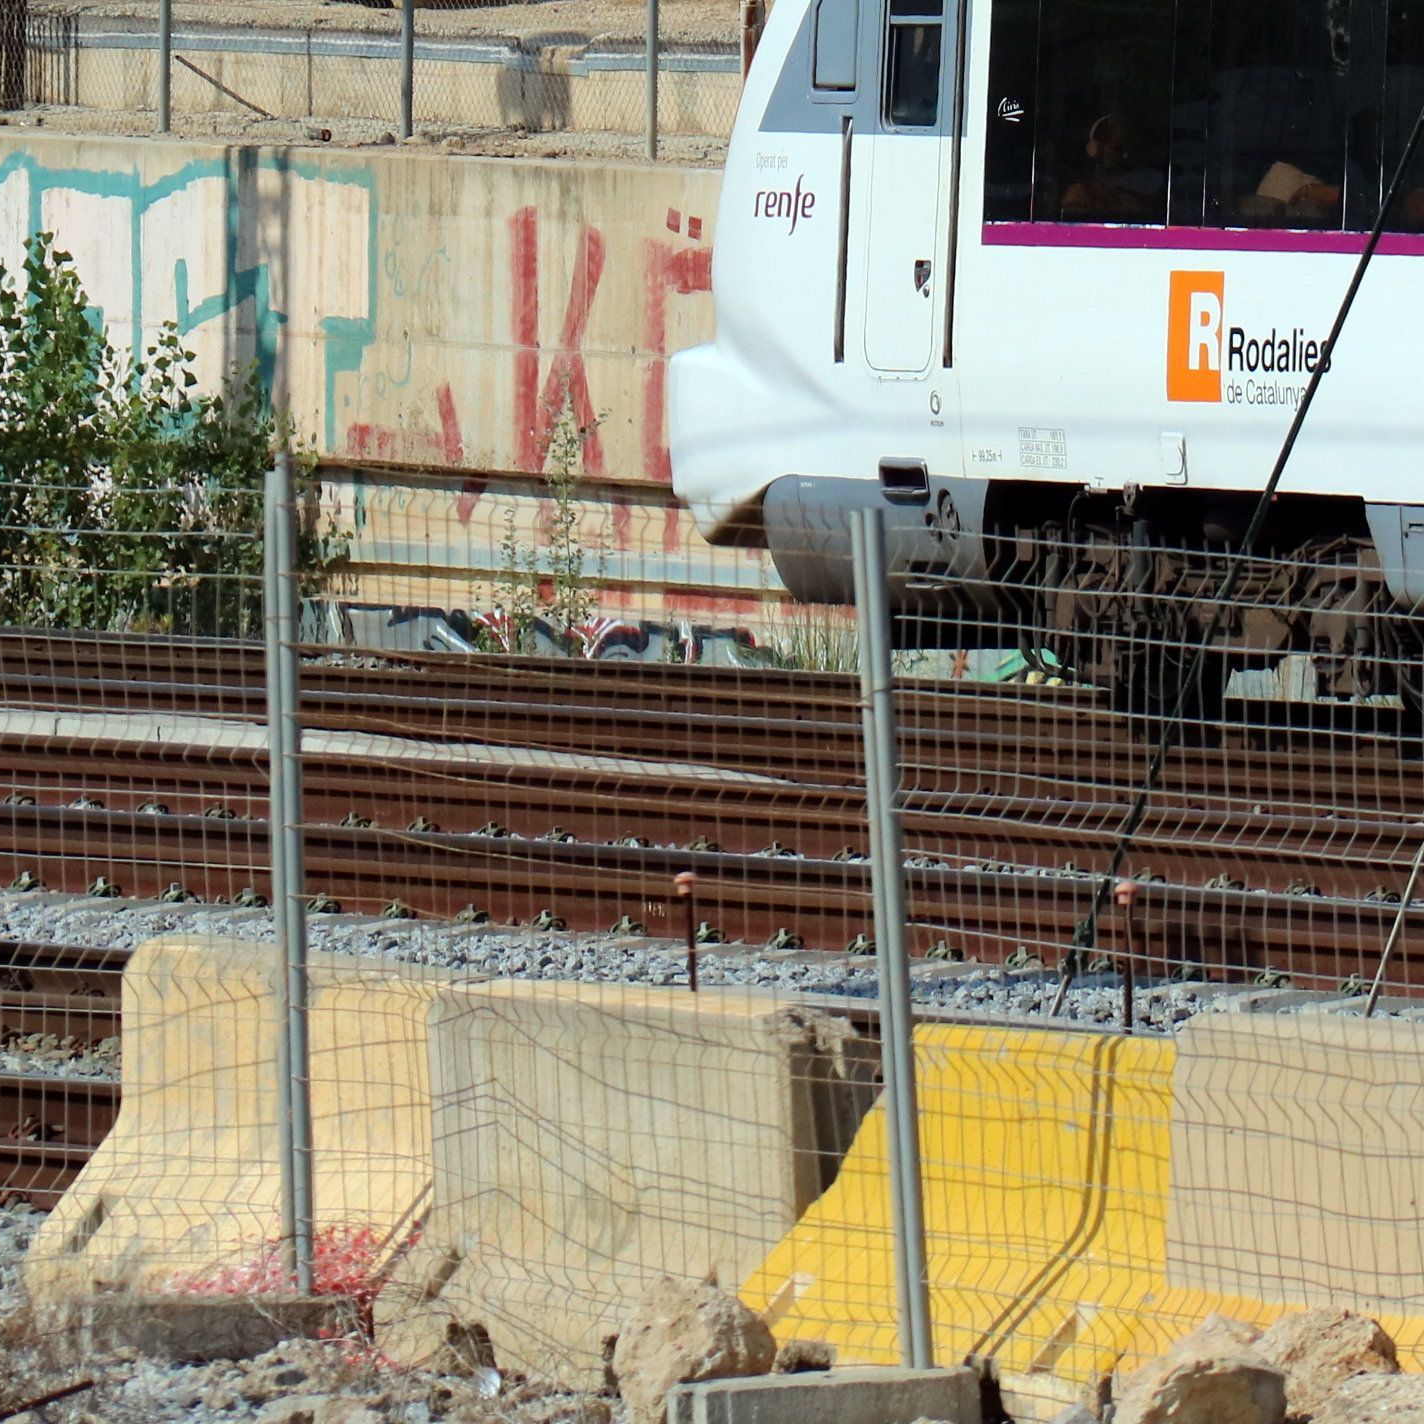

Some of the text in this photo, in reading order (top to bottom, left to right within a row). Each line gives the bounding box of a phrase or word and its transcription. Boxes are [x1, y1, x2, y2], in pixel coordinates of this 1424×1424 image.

[754, 173, 816, 236] renfe
[1188, 292, 1221, 371] R
[1229, 327, 1331, 373] Rodalies
[1227, 379, 1308, 412] de Catalunya
